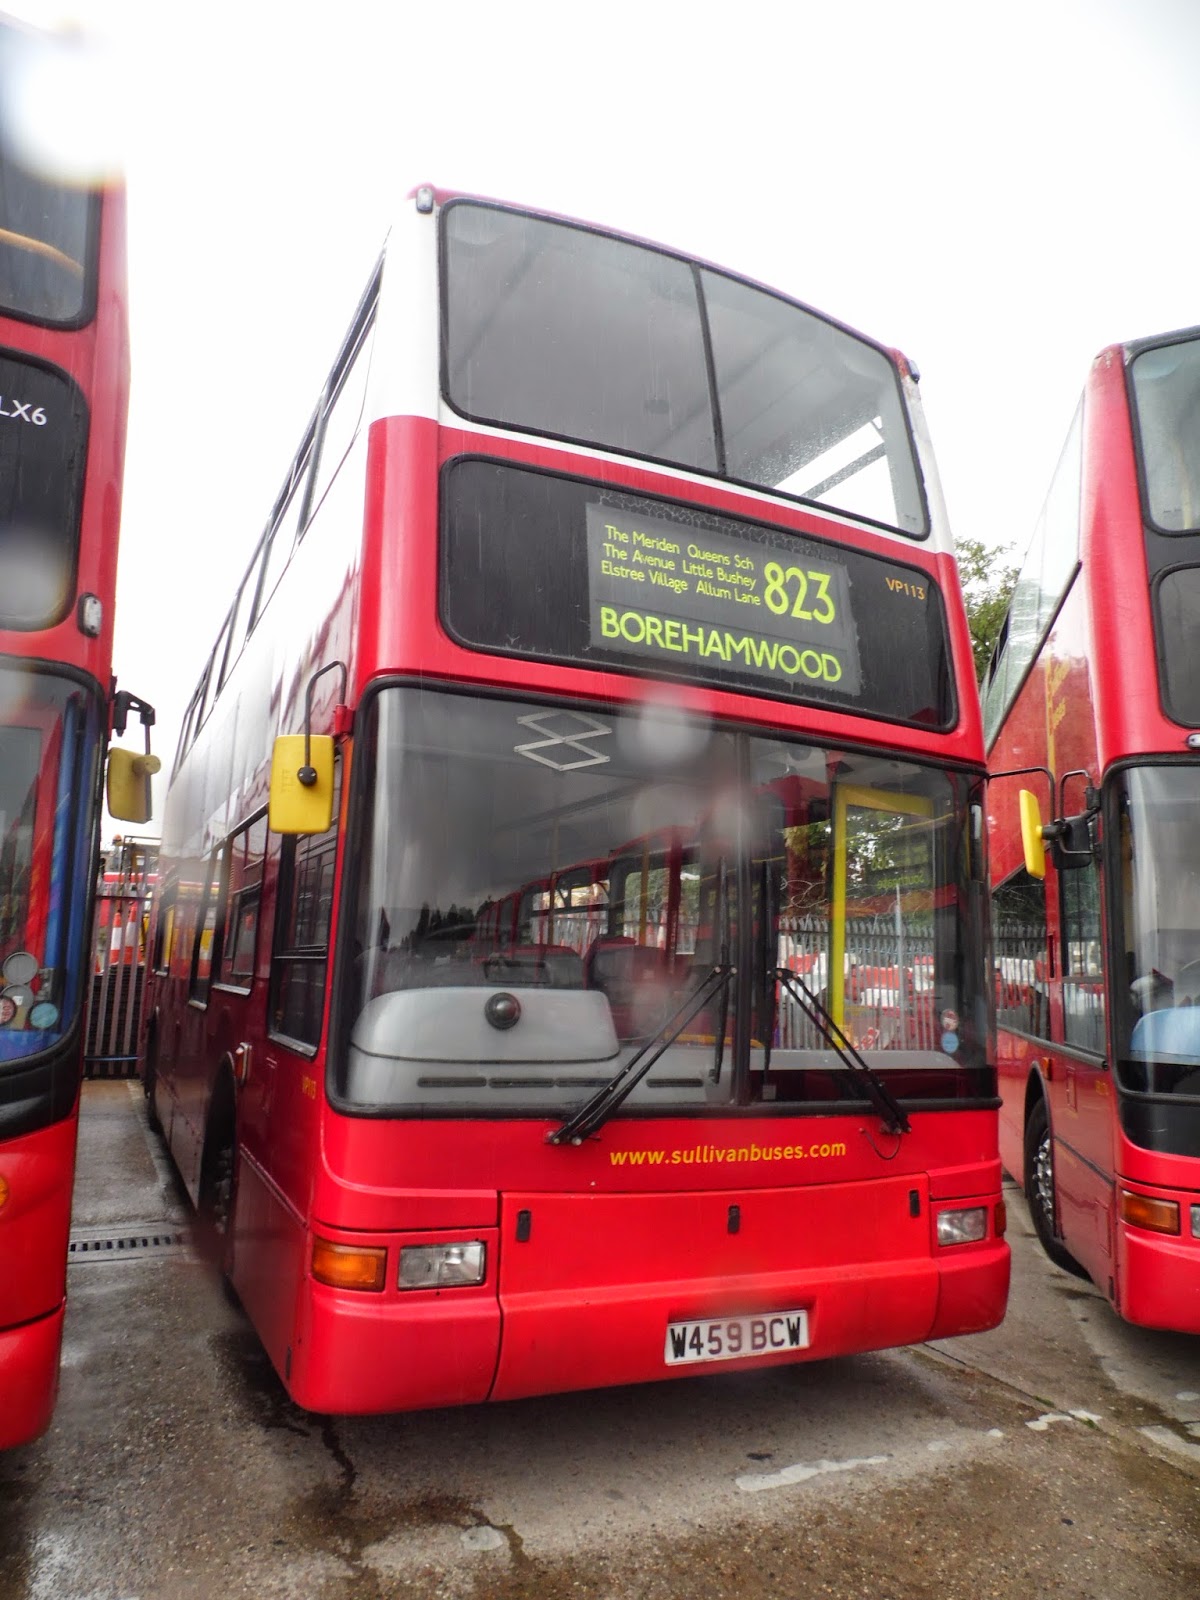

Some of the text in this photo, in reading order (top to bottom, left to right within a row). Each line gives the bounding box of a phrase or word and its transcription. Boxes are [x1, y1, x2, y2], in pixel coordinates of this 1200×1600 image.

[603, 543, 757, 591] The Avenue Little Bushey
[605, 525, 754, 570] The Meriden Queens Sch
[601, 560, 761, 605] Elstree Village Allum Lane
[764, 562, 835, 625] 823
[885, 577, 926, 600] VP113
[600, 606, 842, 682] BOREHAMWOOD
[610, 1143, 847, 1165] www.sullivanbuses.com
[670, 1316, 801, 1359] W459 BCW
